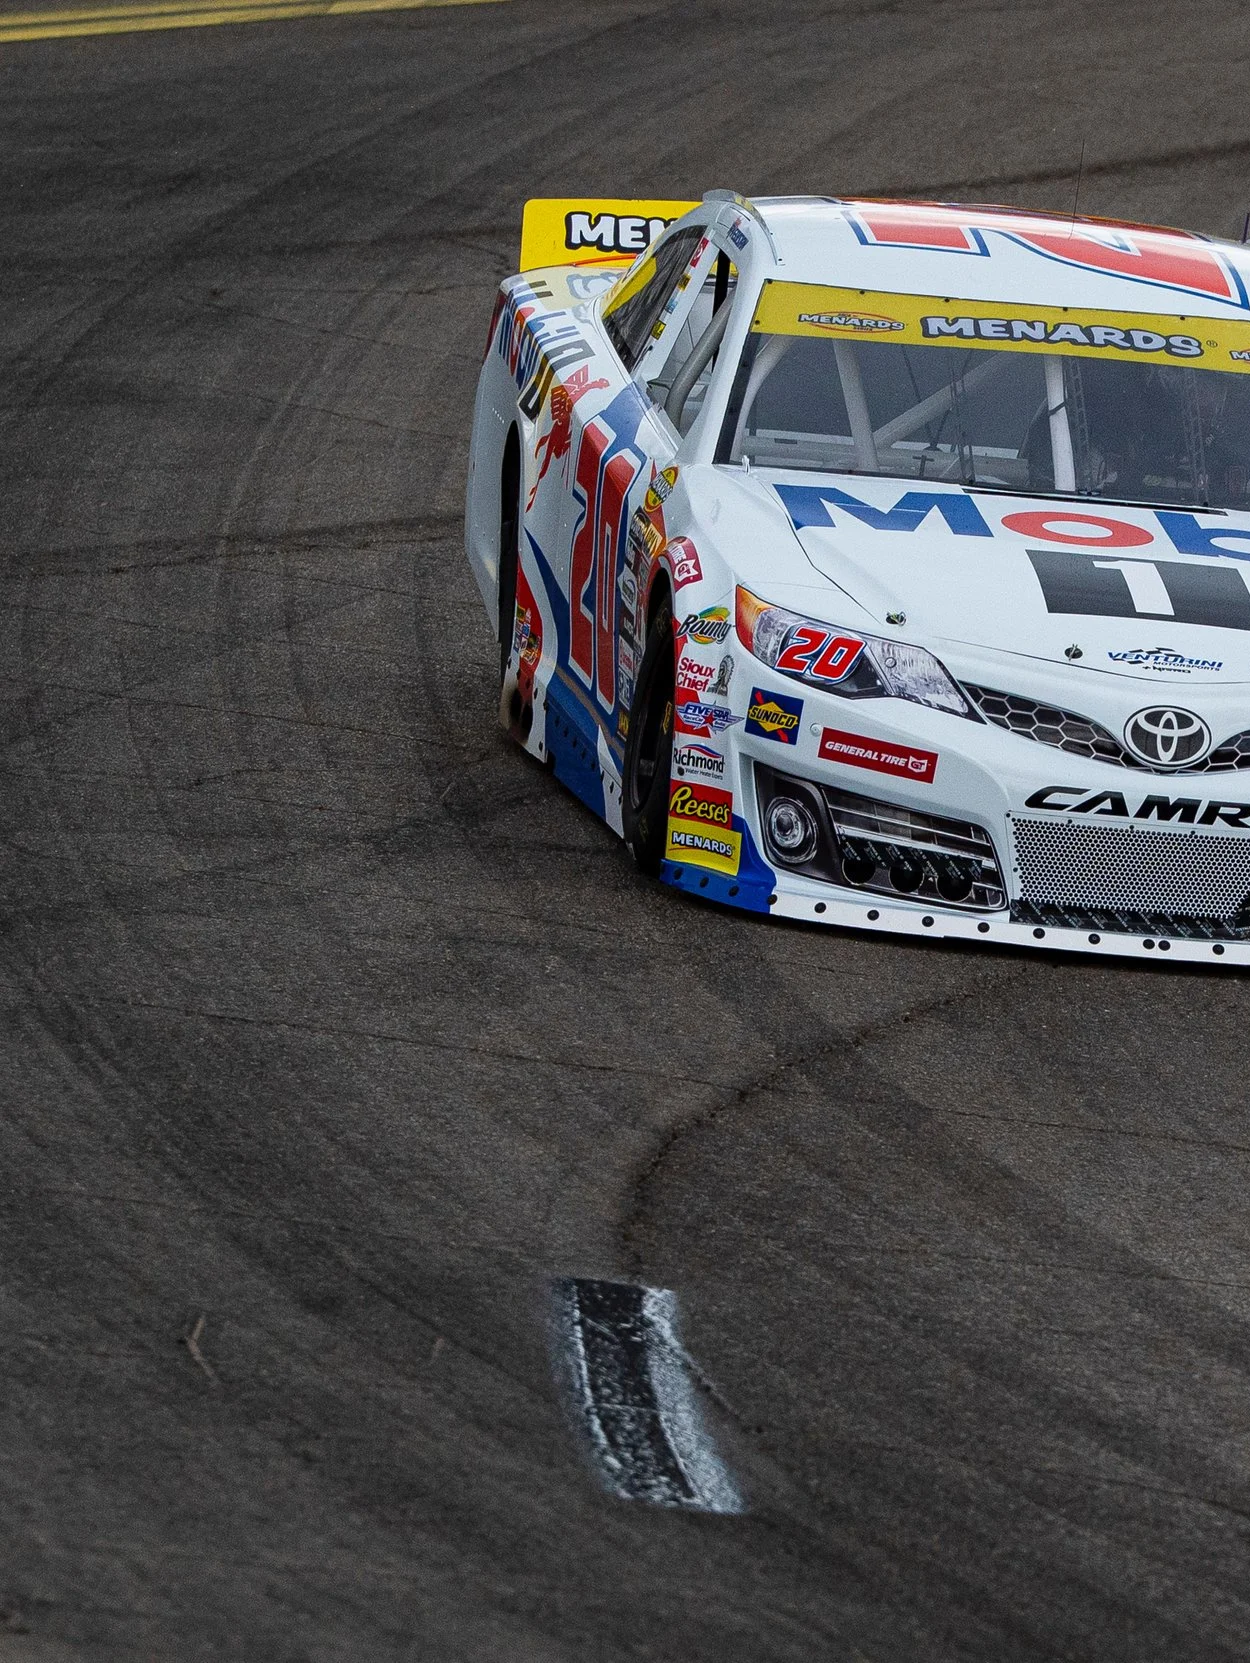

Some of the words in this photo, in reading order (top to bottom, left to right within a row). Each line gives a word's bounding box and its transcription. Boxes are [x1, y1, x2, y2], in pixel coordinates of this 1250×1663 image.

[798, 313, 906, 331] MENARDS
[920, 316, 1204, 358] MENARDS
[1092, 559, 1175, 616] 1
[676, 614, 733, 645] Bounty
[774, 626, 867, 680] 20
[1107, 651, 1223, 668] VENTURINI
[1153, 661, 1221, 671] MOTORSPORTS
[678, 657, 716, 679] Sioux
[676, 672, 710, 693] Chief
[685, 704, 712, 716] FIVE
[749, 706, 797, 730] SUNOCO
[673, 748, 724, 774] Richmond
[825, 741, 879, 761] GENERAL
[880, 753, 908, 767] TIRE
[670, 786, 731, 824] Reese's
[672, 831, 735, 857] MENARDS
